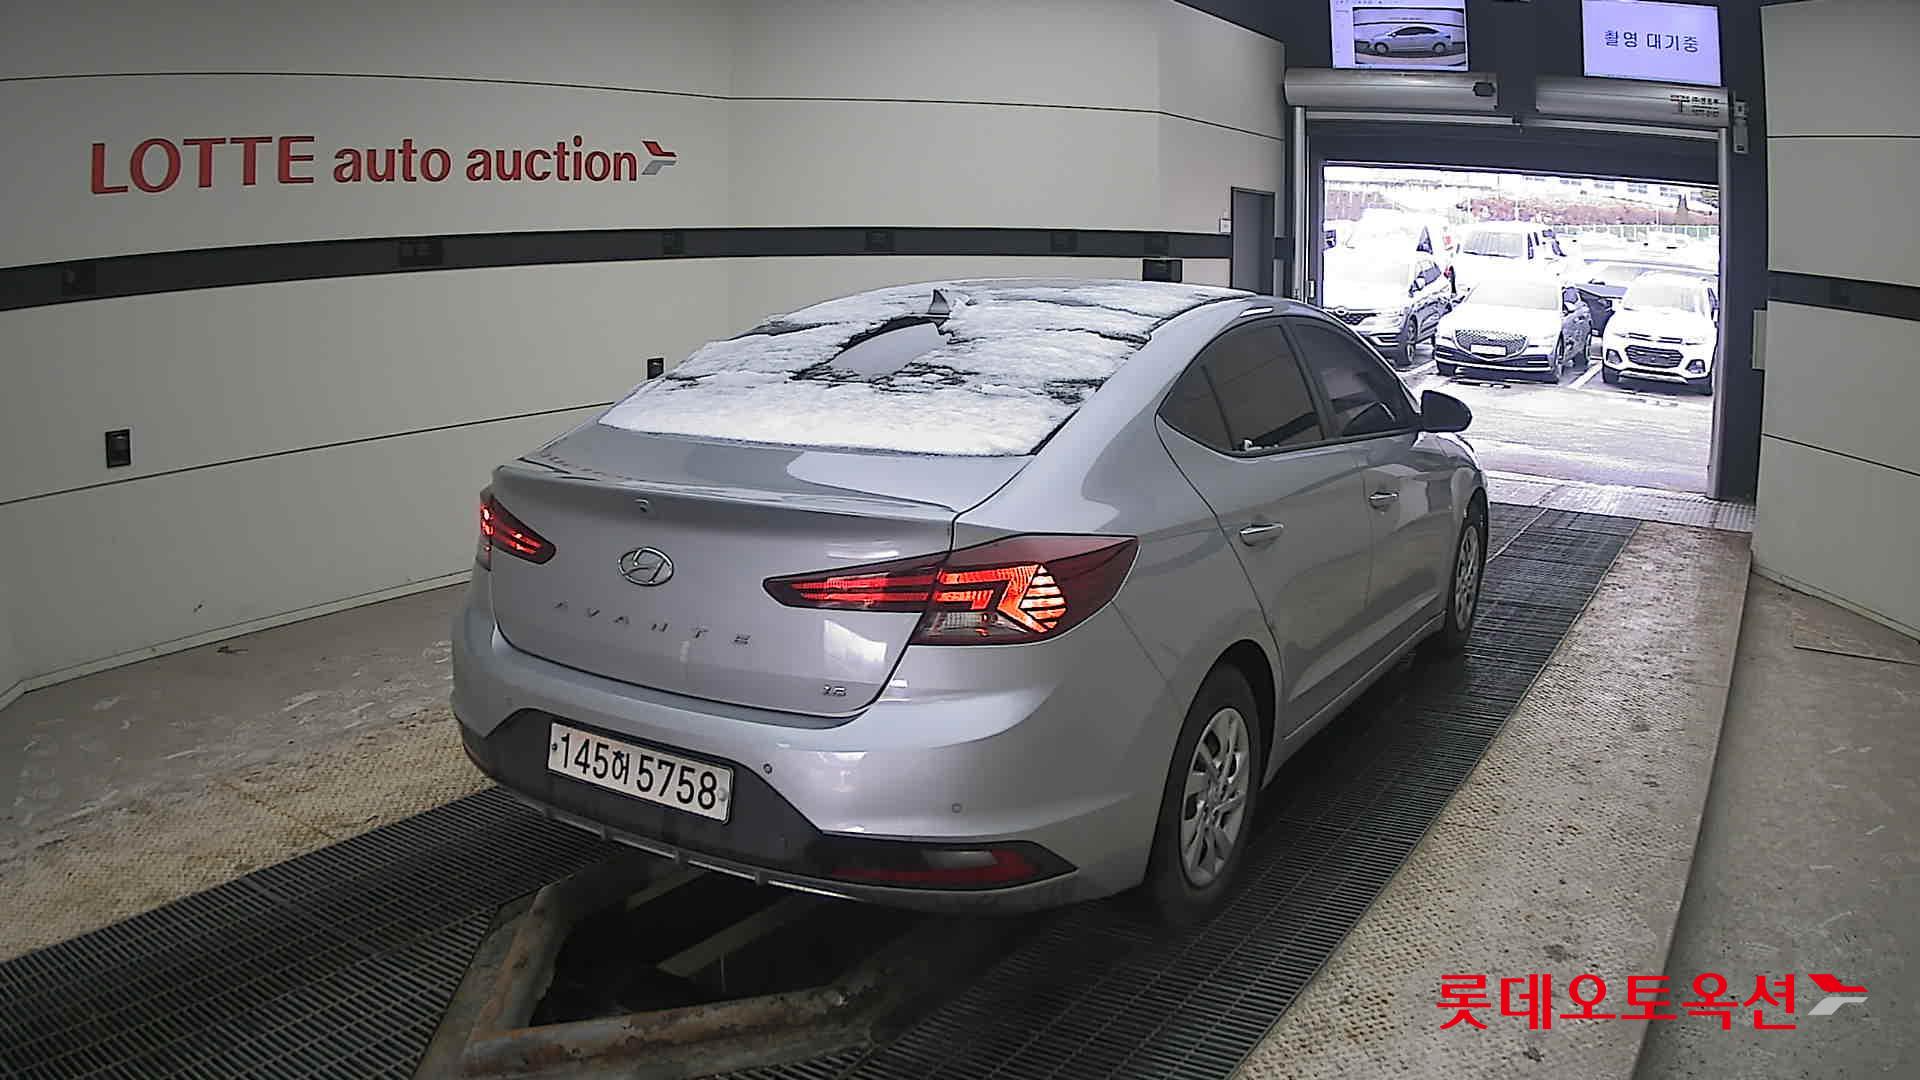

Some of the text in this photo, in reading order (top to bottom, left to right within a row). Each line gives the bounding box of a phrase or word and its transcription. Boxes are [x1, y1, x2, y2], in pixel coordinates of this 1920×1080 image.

[1604, 30, 1698, 53] 촬영 대기중
[91, 135, 638, 194] LOTTE auto auction
[553, 600, 752, 646] AVANTE
